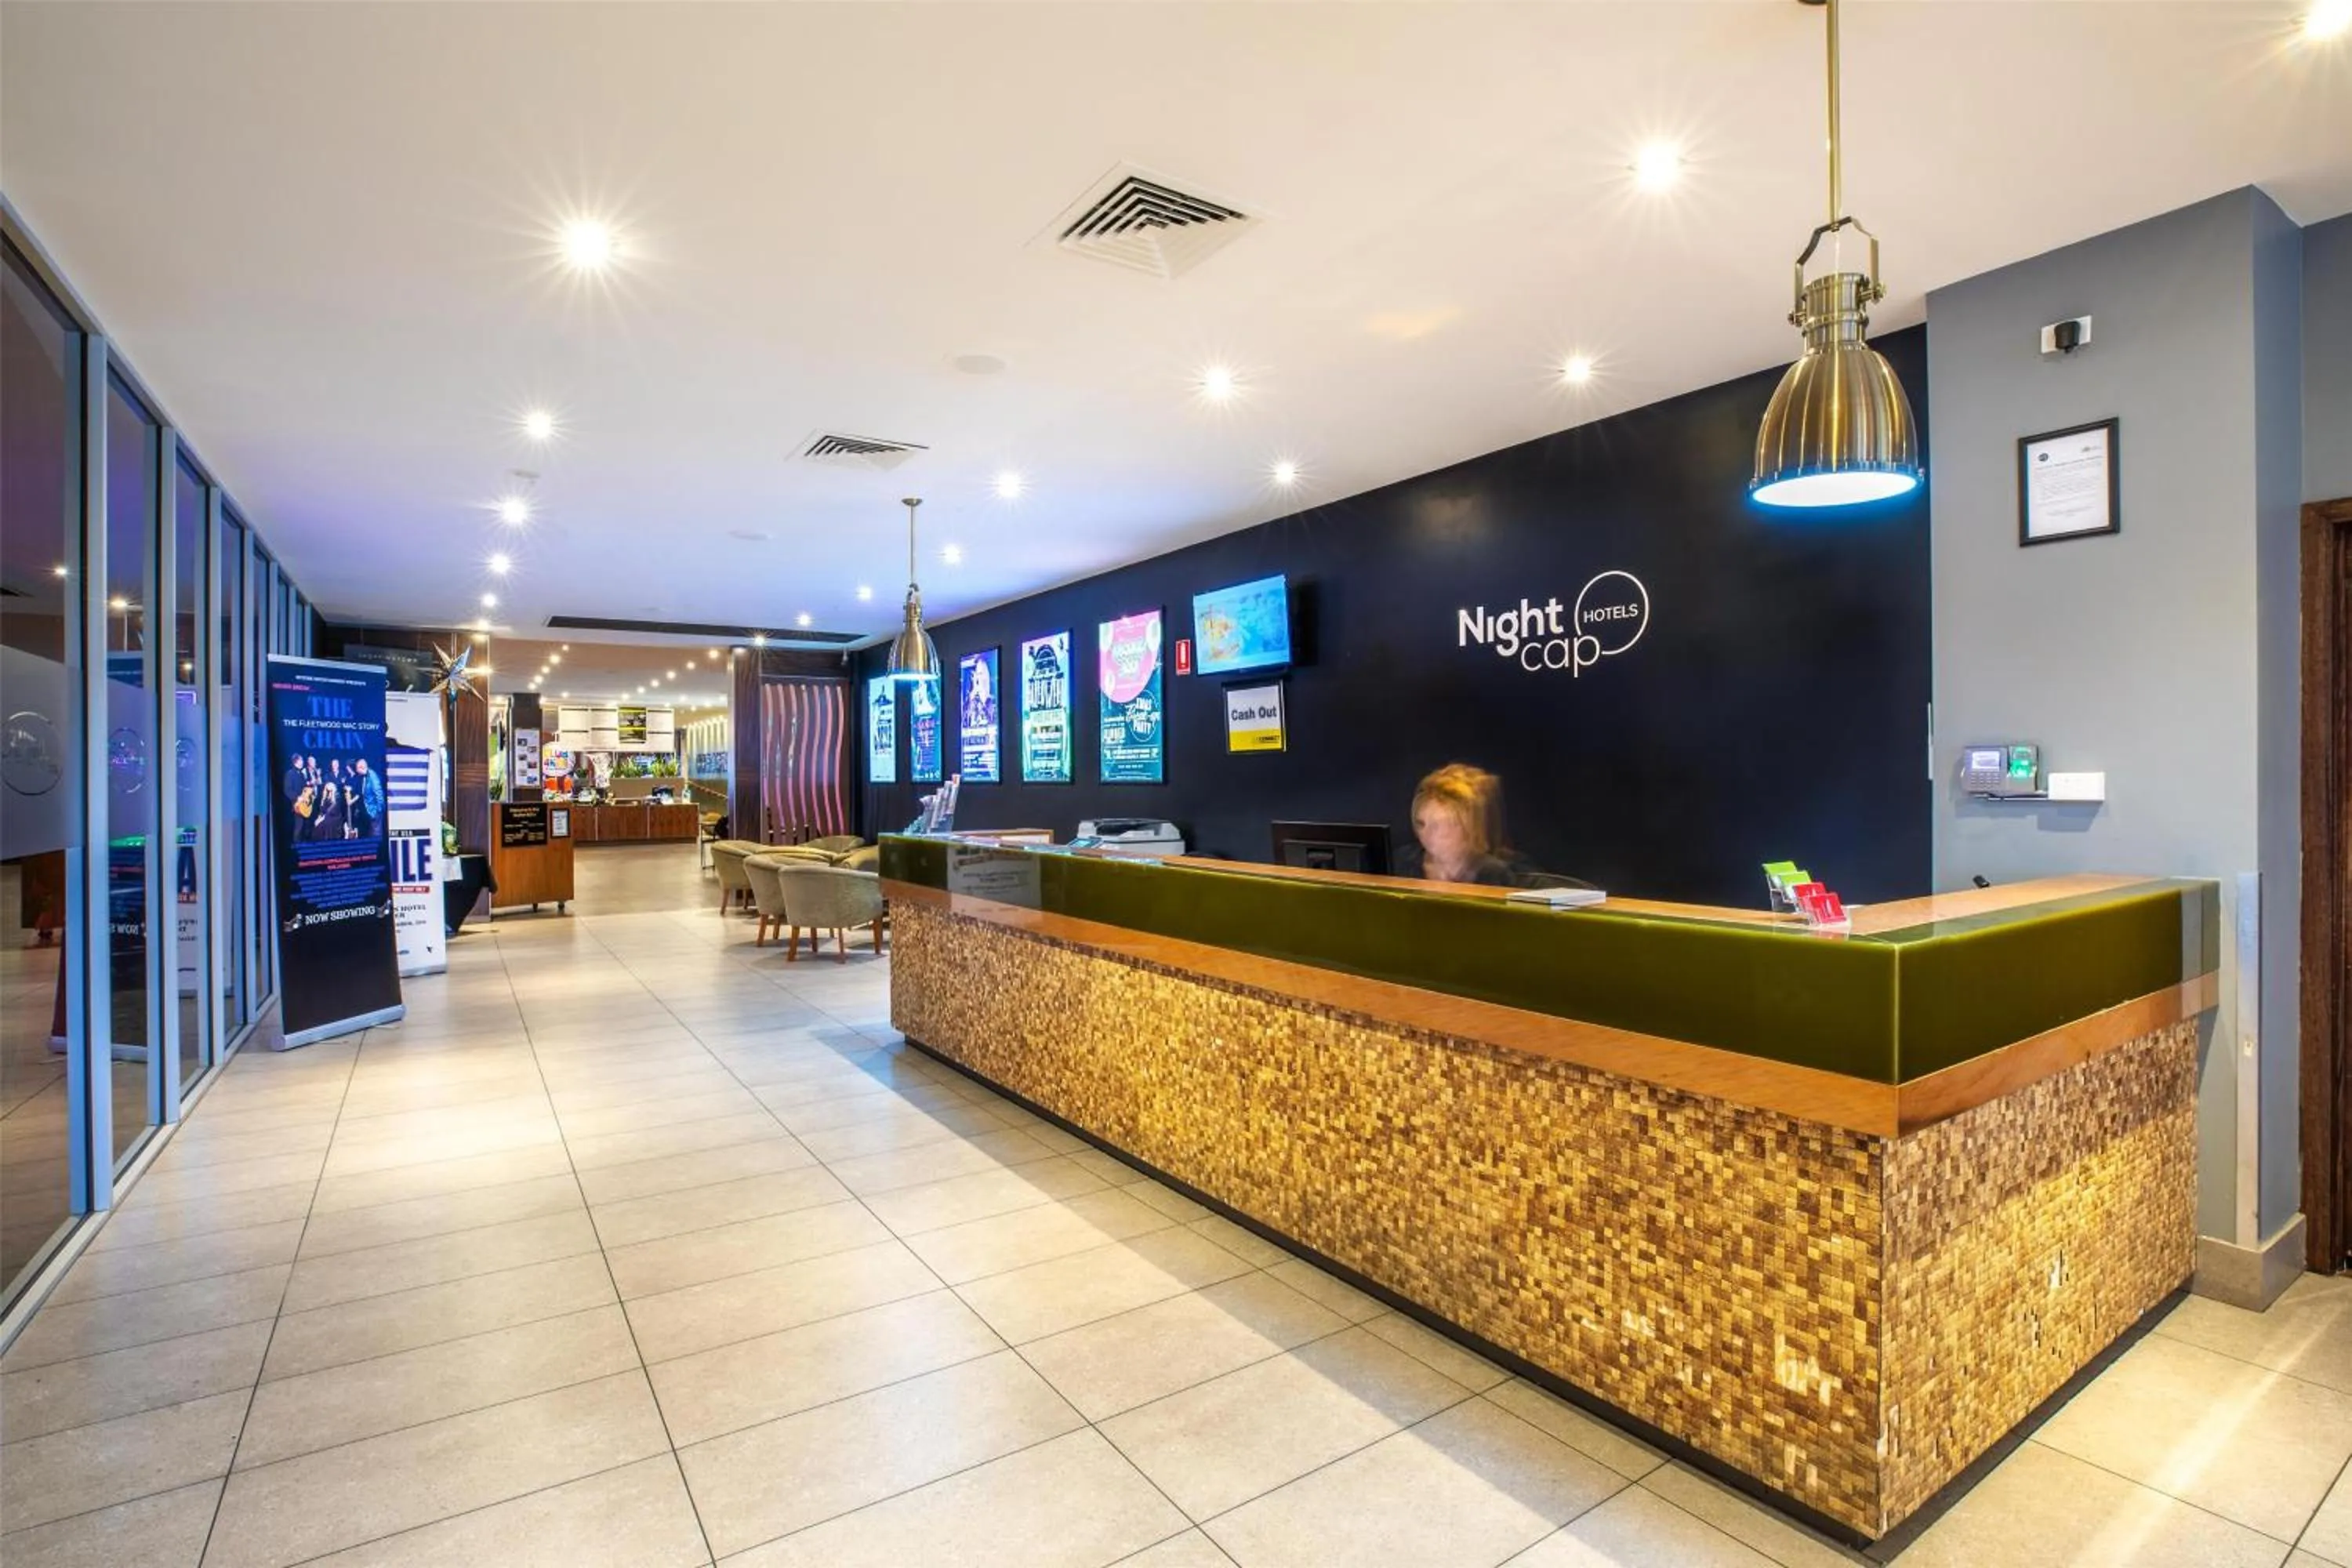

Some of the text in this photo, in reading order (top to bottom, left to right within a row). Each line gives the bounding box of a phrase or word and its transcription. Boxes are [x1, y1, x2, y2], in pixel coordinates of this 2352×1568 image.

[1584, 603, 1639, 623] HOTELS
[1458, 598, 1564, 656] Night
[1520, 635, 1600, 677] cap
[307, 695, 354, 719] THE
[1231, 706, 1277, 721] Cash Out
[299, 720, 341, 729] FLEETWOOD
[303, 729, 364, 750] CHAIN
[390, 838, 433, 883] ILE
[305, 906, 376, 925] NOW SHOWING
